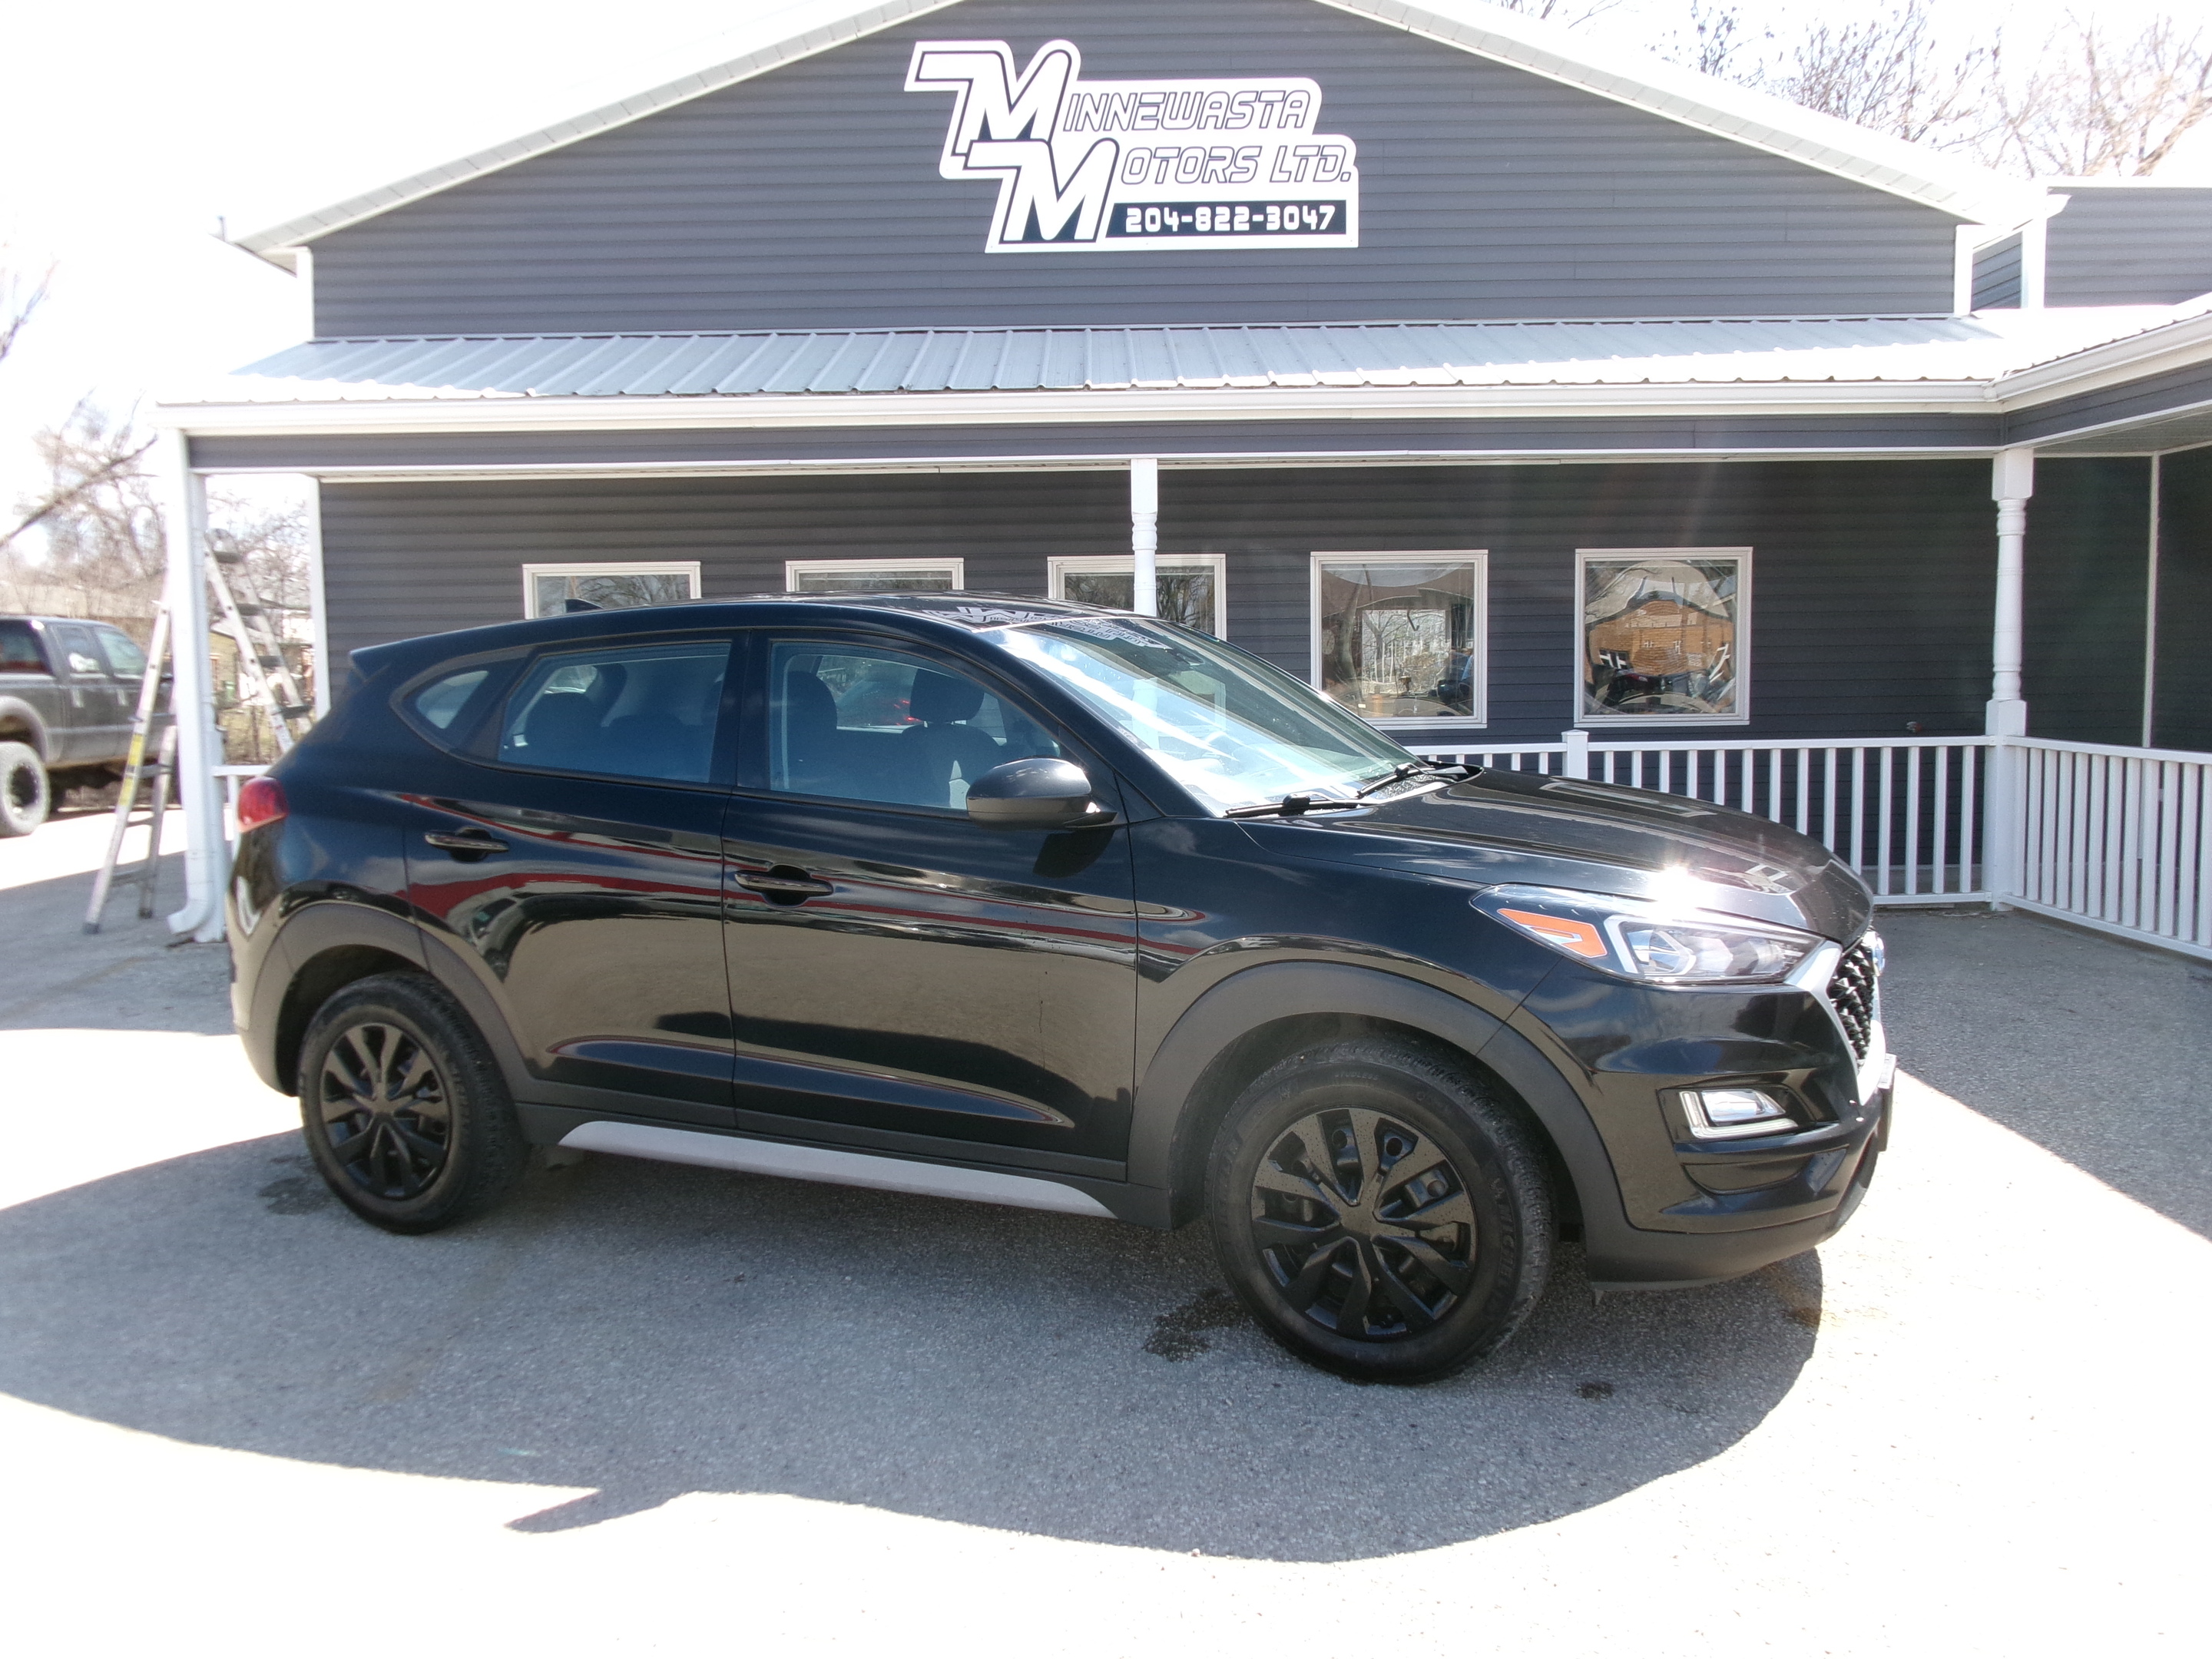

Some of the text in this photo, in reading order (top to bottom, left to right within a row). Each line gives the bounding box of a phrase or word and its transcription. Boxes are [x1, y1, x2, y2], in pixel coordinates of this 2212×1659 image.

[964, 137, 1352, 243] MOTORS LTD.
[1125, 204, 1336, 233] 204-822-3047
